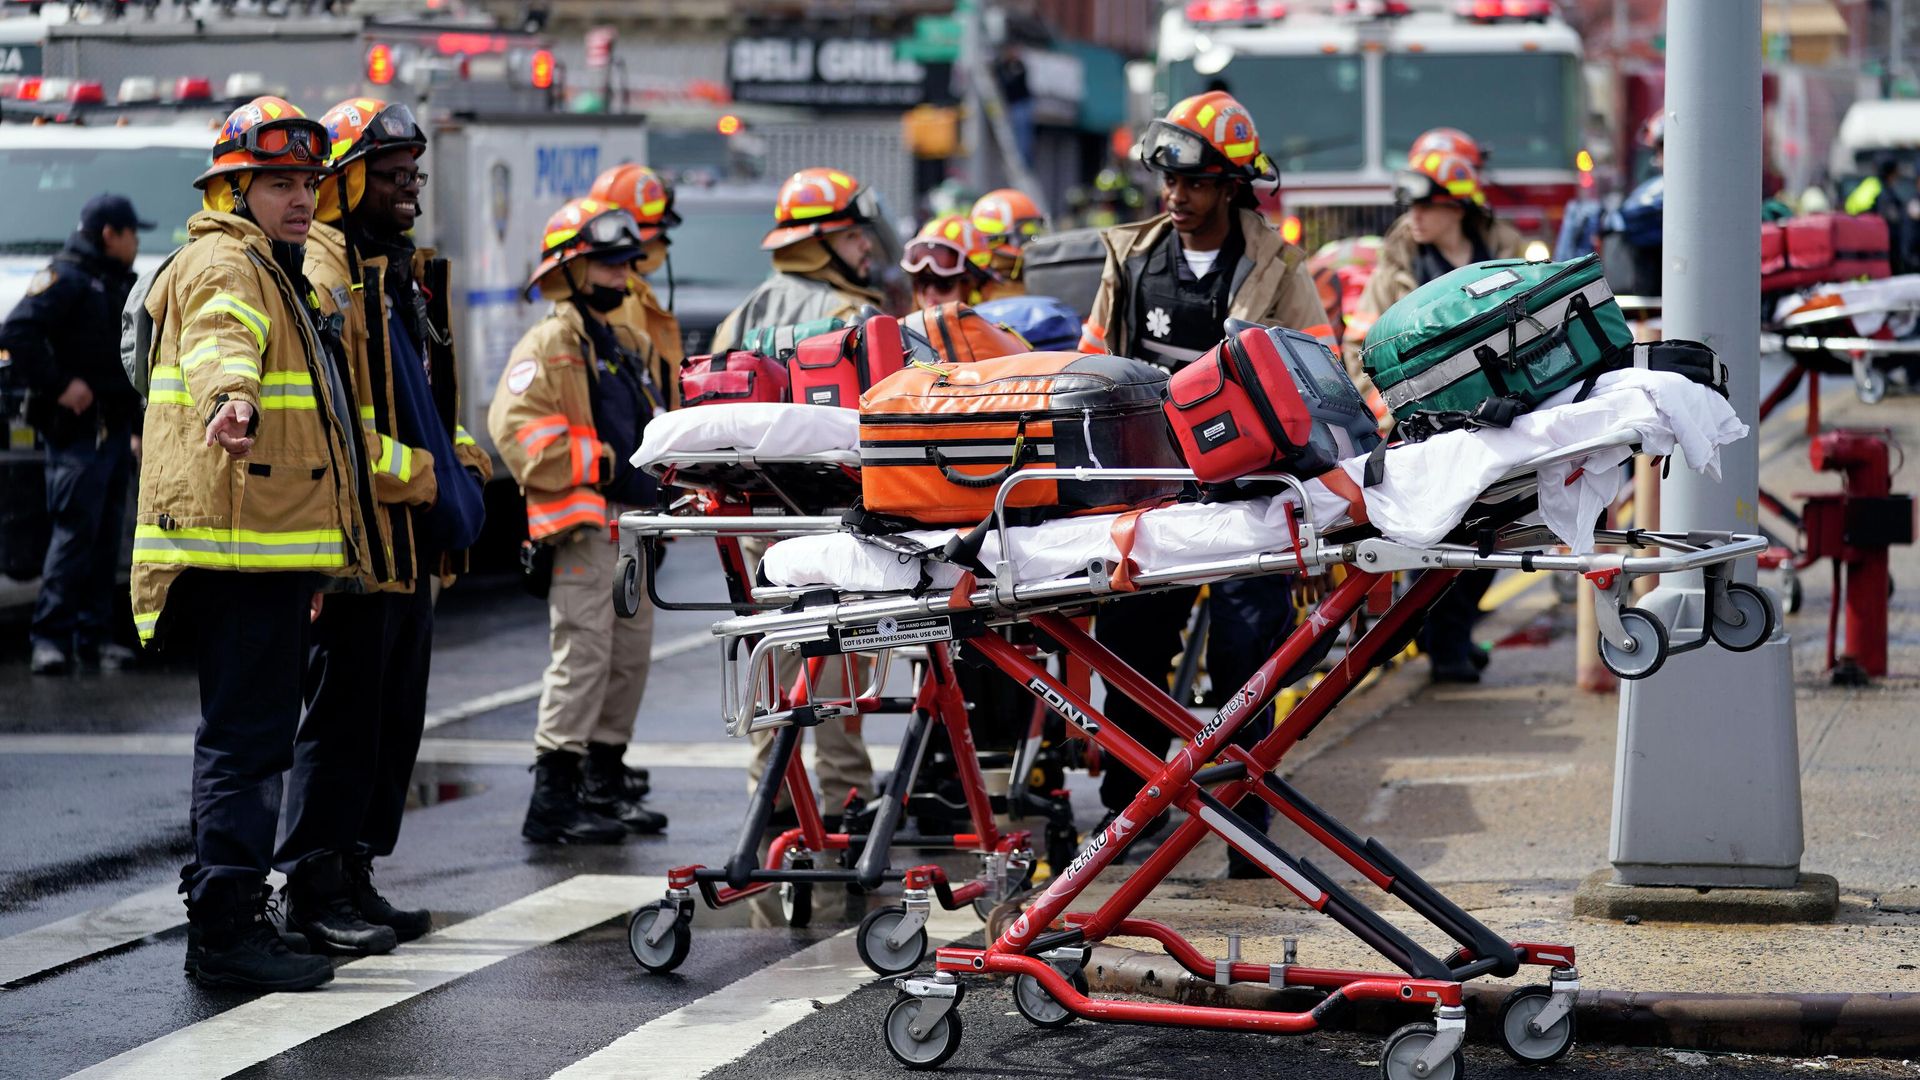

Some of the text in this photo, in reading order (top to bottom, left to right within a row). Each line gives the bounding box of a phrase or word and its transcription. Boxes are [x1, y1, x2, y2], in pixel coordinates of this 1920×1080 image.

[732, 36, 814, 82] DELI
[862, 637, 875, 645] FOR
[875, 632, 919, 643] PROFESSIONAL
[920, 630, 932, 638] USE
[933, 628, 949, 637] ONLY
[920, 620, 937, 628] GUARD
[1029, 678, 1100, 730] FDNY
[1066, 830, 1109, 880] FERNO
